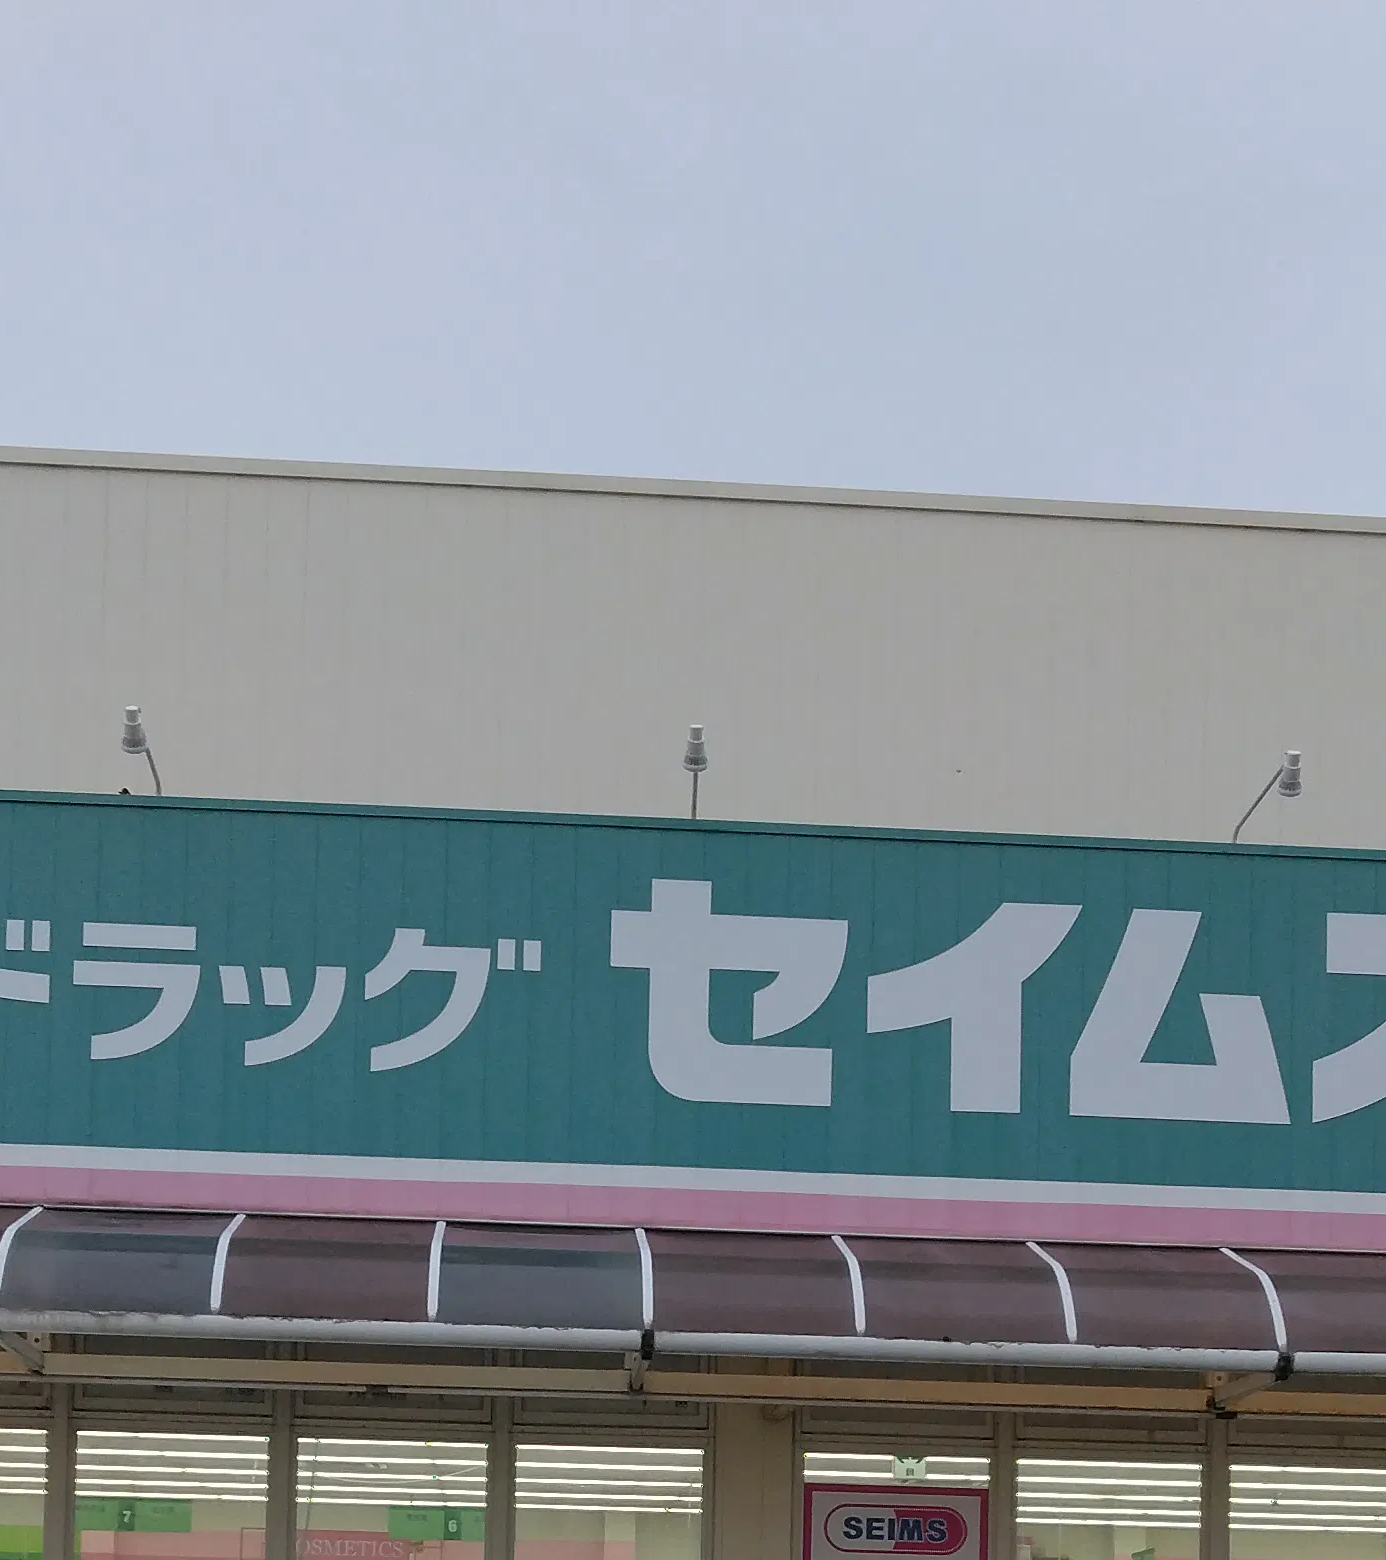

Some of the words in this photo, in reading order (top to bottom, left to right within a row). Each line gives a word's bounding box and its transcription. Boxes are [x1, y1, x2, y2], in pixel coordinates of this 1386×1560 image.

[122, 1510, 132, 1523] 7
[842, 1516, 947, 1543] SEIMS
[295, 1538, 405, 1559] OSMETICS
